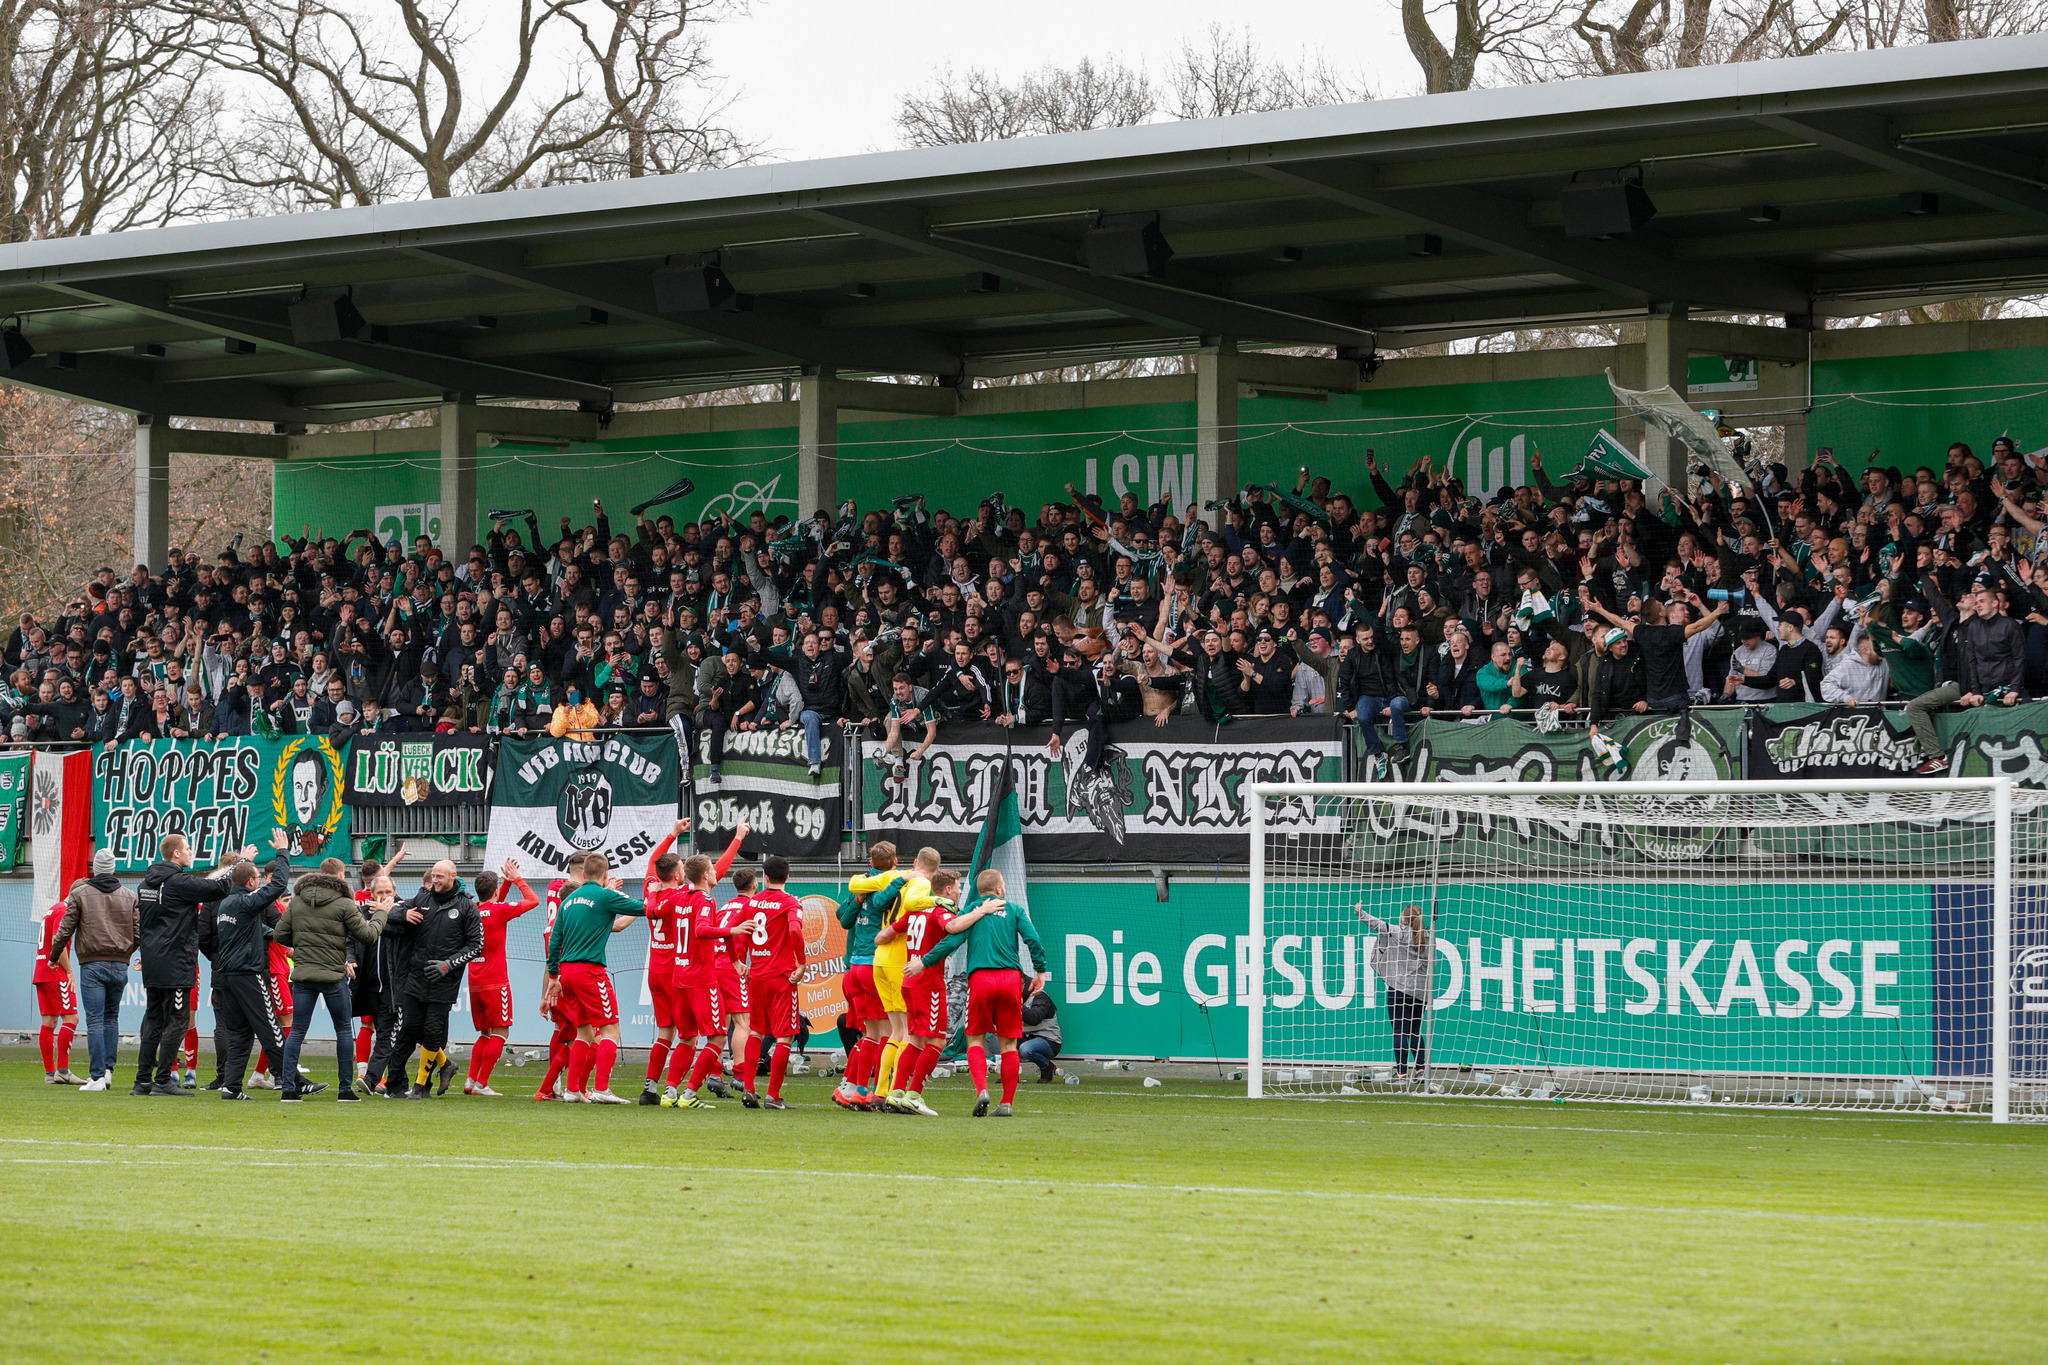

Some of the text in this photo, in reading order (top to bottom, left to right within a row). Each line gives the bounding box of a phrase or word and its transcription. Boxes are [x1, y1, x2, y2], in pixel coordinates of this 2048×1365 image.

[404, 745, 431, 755] LÜBECK
[517, 739, 662, 785] VfB FAN CLUB
[96, 746, 260, 803] HOPPES
[577, 772, 598, 785] 1919
[106, 805, 249, 862] ERBEN
[699, 797, 775, 834] Lbeck
[516, 830, 656, 873] KRUMESSE
[676, 917, 689, 954] 17
[752, 911, 768, 946] 8
[906, 914, 927, 951] 39
[804, 939, 828, 957] AOK
[797, 956, 847, 985] SPUNK
[1065, 930, 1163, 1006] Die
[807, 986, 833, 1004] Mehr
